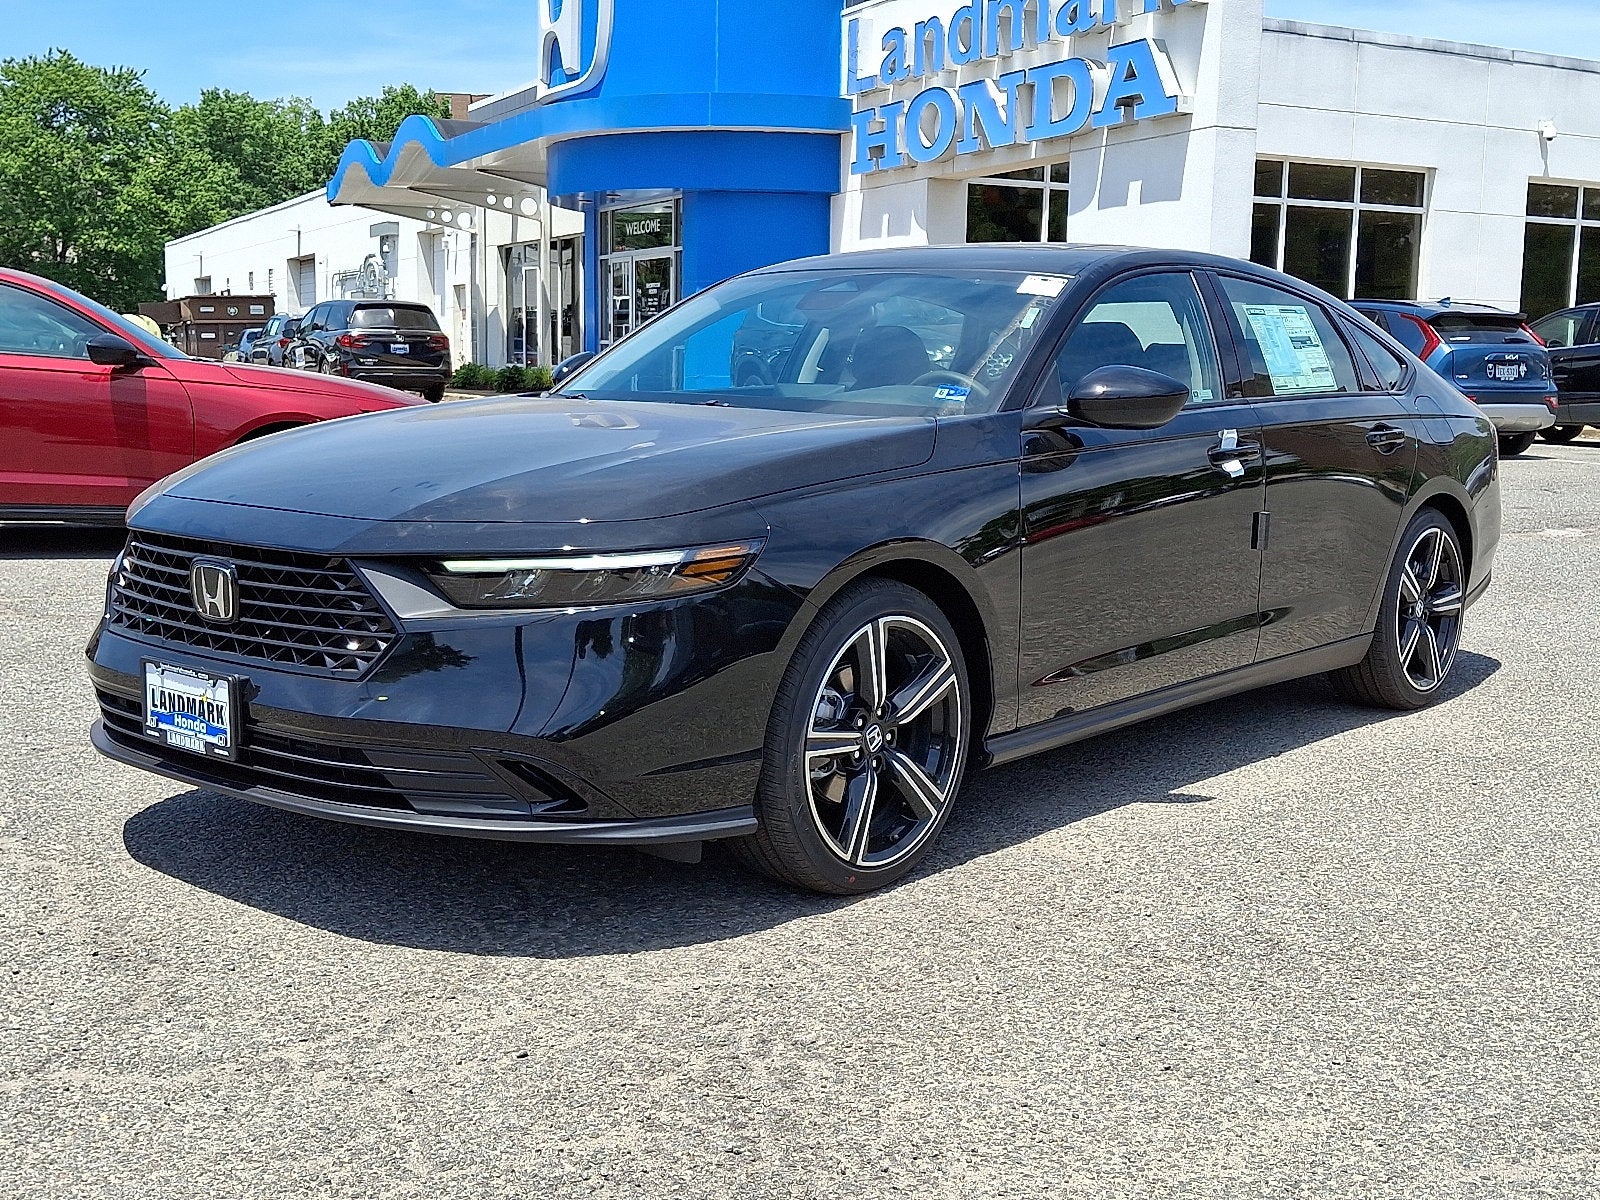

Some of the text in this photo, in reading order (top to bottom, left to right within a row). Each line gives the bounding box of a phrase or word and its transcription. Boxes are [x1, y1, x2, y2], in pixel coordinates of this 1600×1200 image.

[847, 0, 1193, 95] Landma
[851, 38, 1178, 175] HONDA
[626, 219, 661, 236] WELCOME
[151, 687, 225, 727] LANDMARK
[174, 713, 207, 734] Honda
